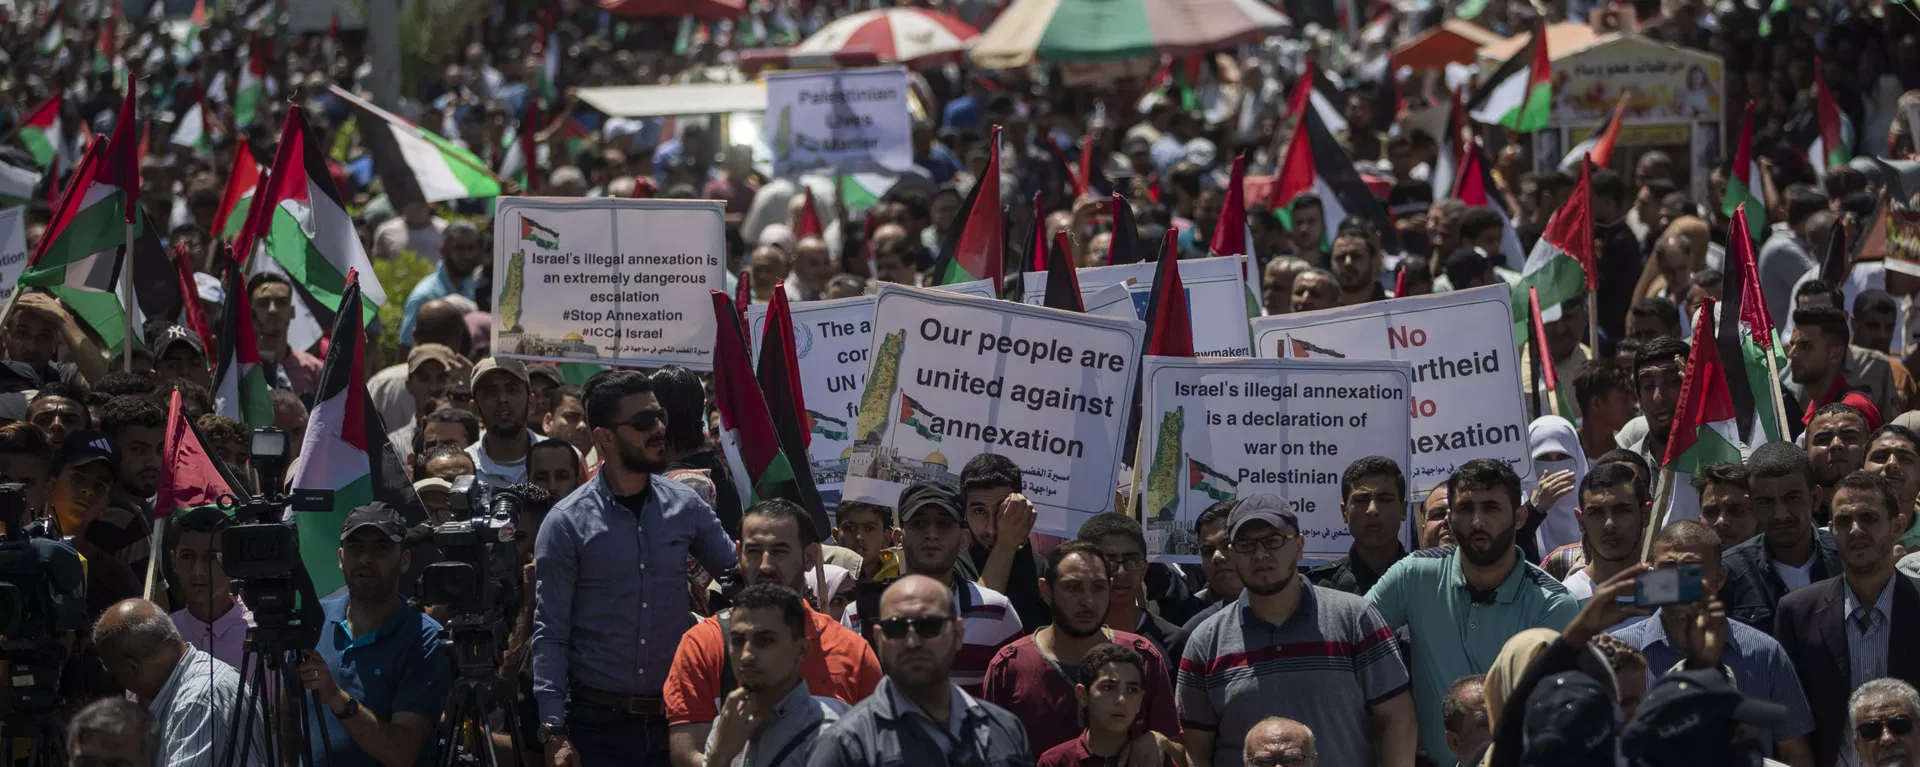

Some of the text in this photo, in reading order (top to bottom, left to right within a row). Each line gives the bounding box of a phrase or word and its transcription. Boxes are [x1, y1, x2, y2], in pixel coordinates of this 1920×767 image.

[798, 88, 897, 105] Palestinian
[532, 252, 718, 268] Israel's illegal annexation is
[543, 272, 706, 288] an extremely dangerous
[590, 291, 660, 303] escalation
[562, 309, 683, 324] #Stop Annexation
[582, 327, 663, 340] #ICC4 Israel
[817, 321, 854, 338] The
[1387, 325, 1427, 350] No
[920, 317, 1124, 372] Our people are
[827, 374, 856, 393] UN
[1175, 380, 1403, 401] Israel's illegal annexation
[916, 368, 1114, 418] united against
[1206, 411, 1368, 428] is a declaration of
[929, 415, 1084, 459] annexation
[1244, 441, 1338, 456] war on the
[1238, 468, 1338, 485] Palestinian
